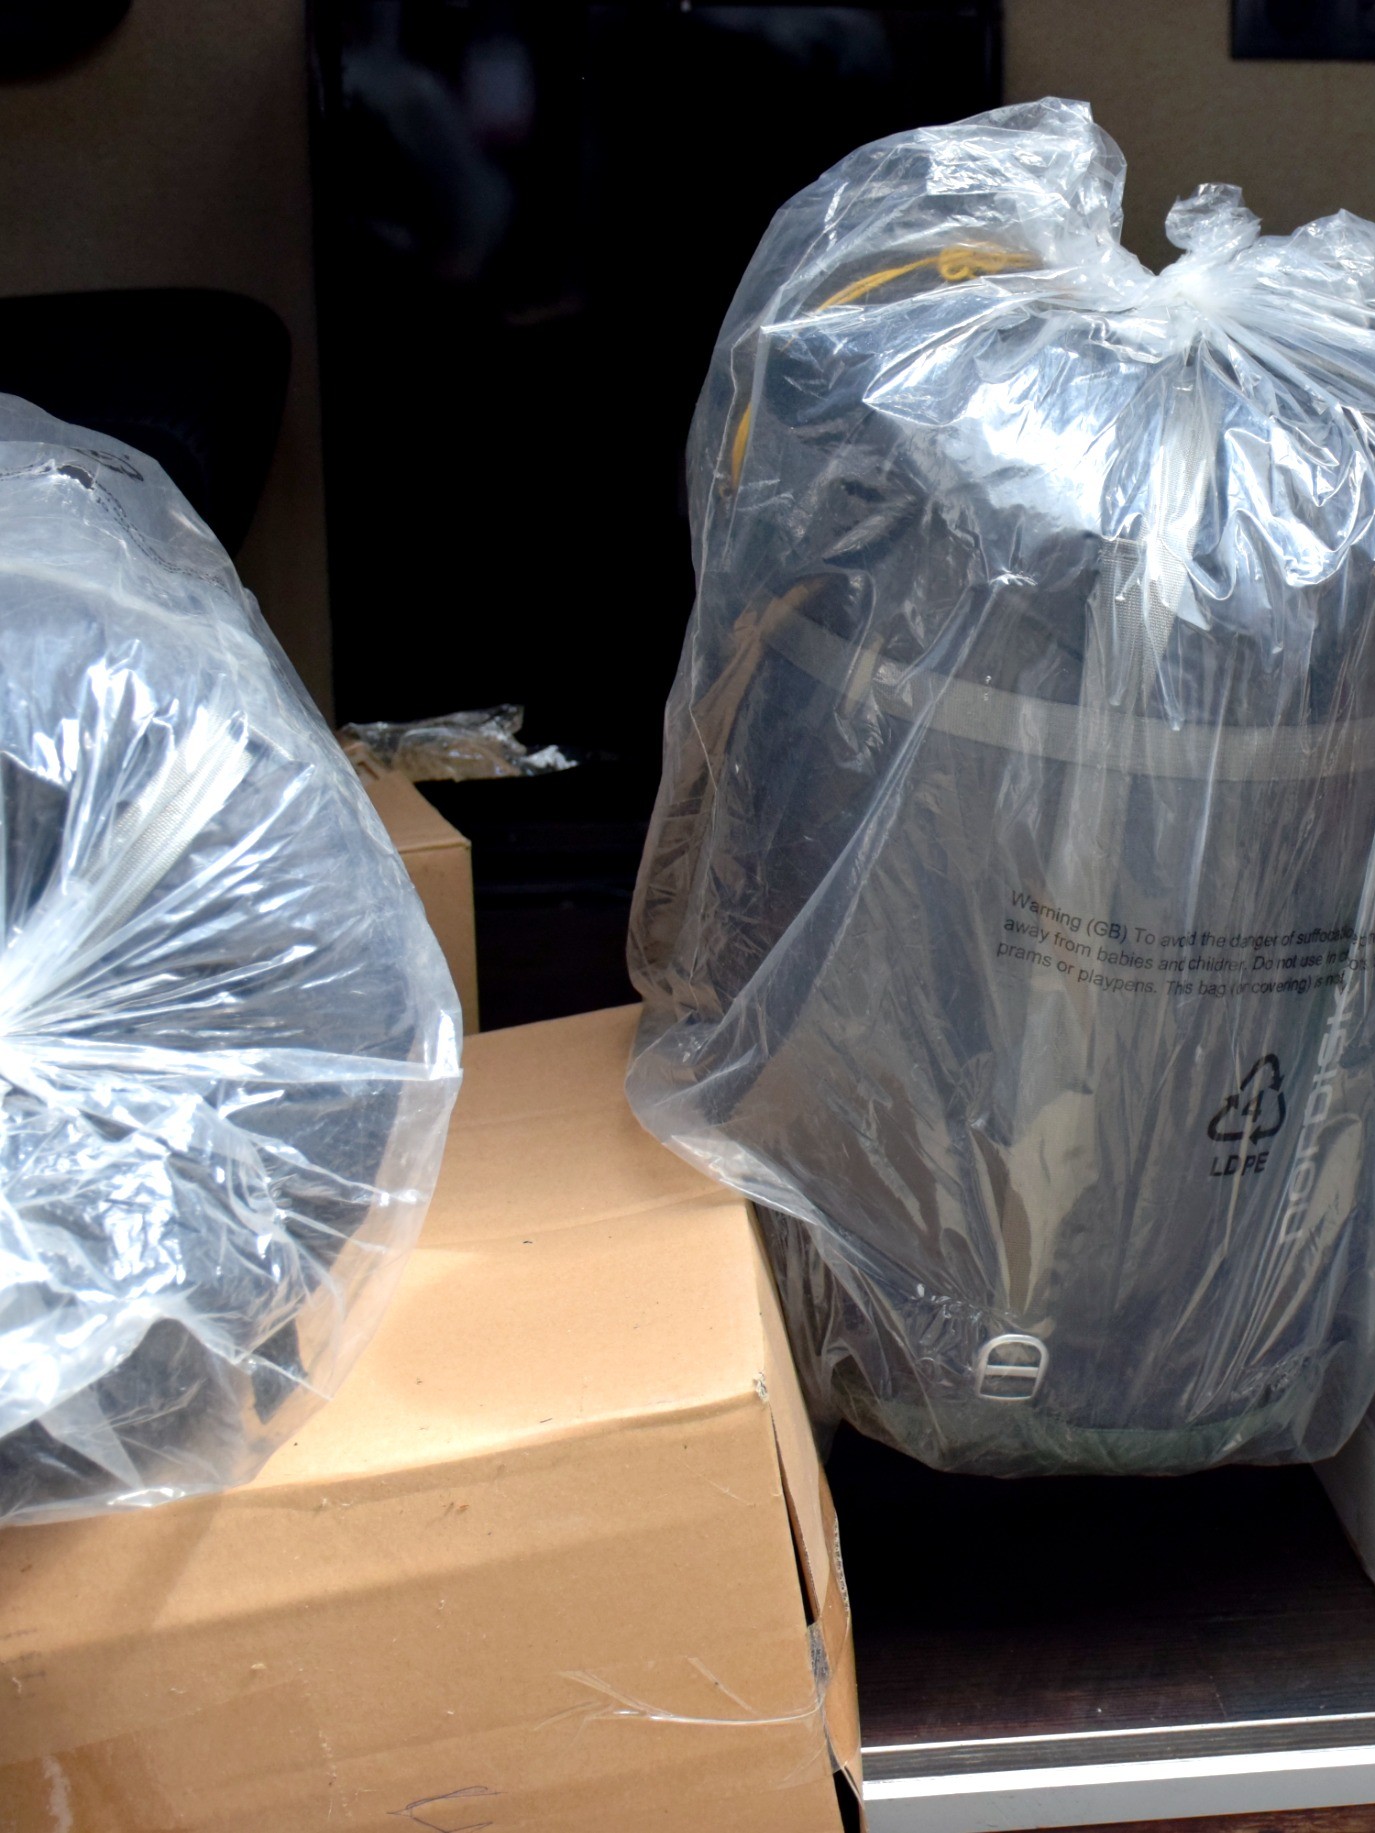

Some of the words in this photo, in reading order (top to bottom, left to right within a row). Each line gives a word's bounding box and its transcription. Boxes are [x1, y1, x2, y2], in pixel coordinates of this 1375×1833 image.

[1004, 918, 1050, 944] away
[1054, 932, 1091, 958] from
[1097, 946, 1154, 970] babies
[1252, 956, 1273, 971] Do
[1300, 954, 1322, 967] use
[1326, 950, 1338, 965] in
[1012, 890, 1082, 933] Warning
[1086, 918, 1128, 945] (GB)
[1134, 927, 1156, 945] To
[1201, 932, 1225, 948] the
[1229, 932, 1278, 950] danger
[1281, 931, 1294, 947] of
[997, 941, 1052, 968] prams
[1056, 960, 1075, 975] or
[1078, 968, 1158, 994] playpens.
[1199, 981, 1226, 998] bag
[1210, 1151, 1270, 1176] LDPE
